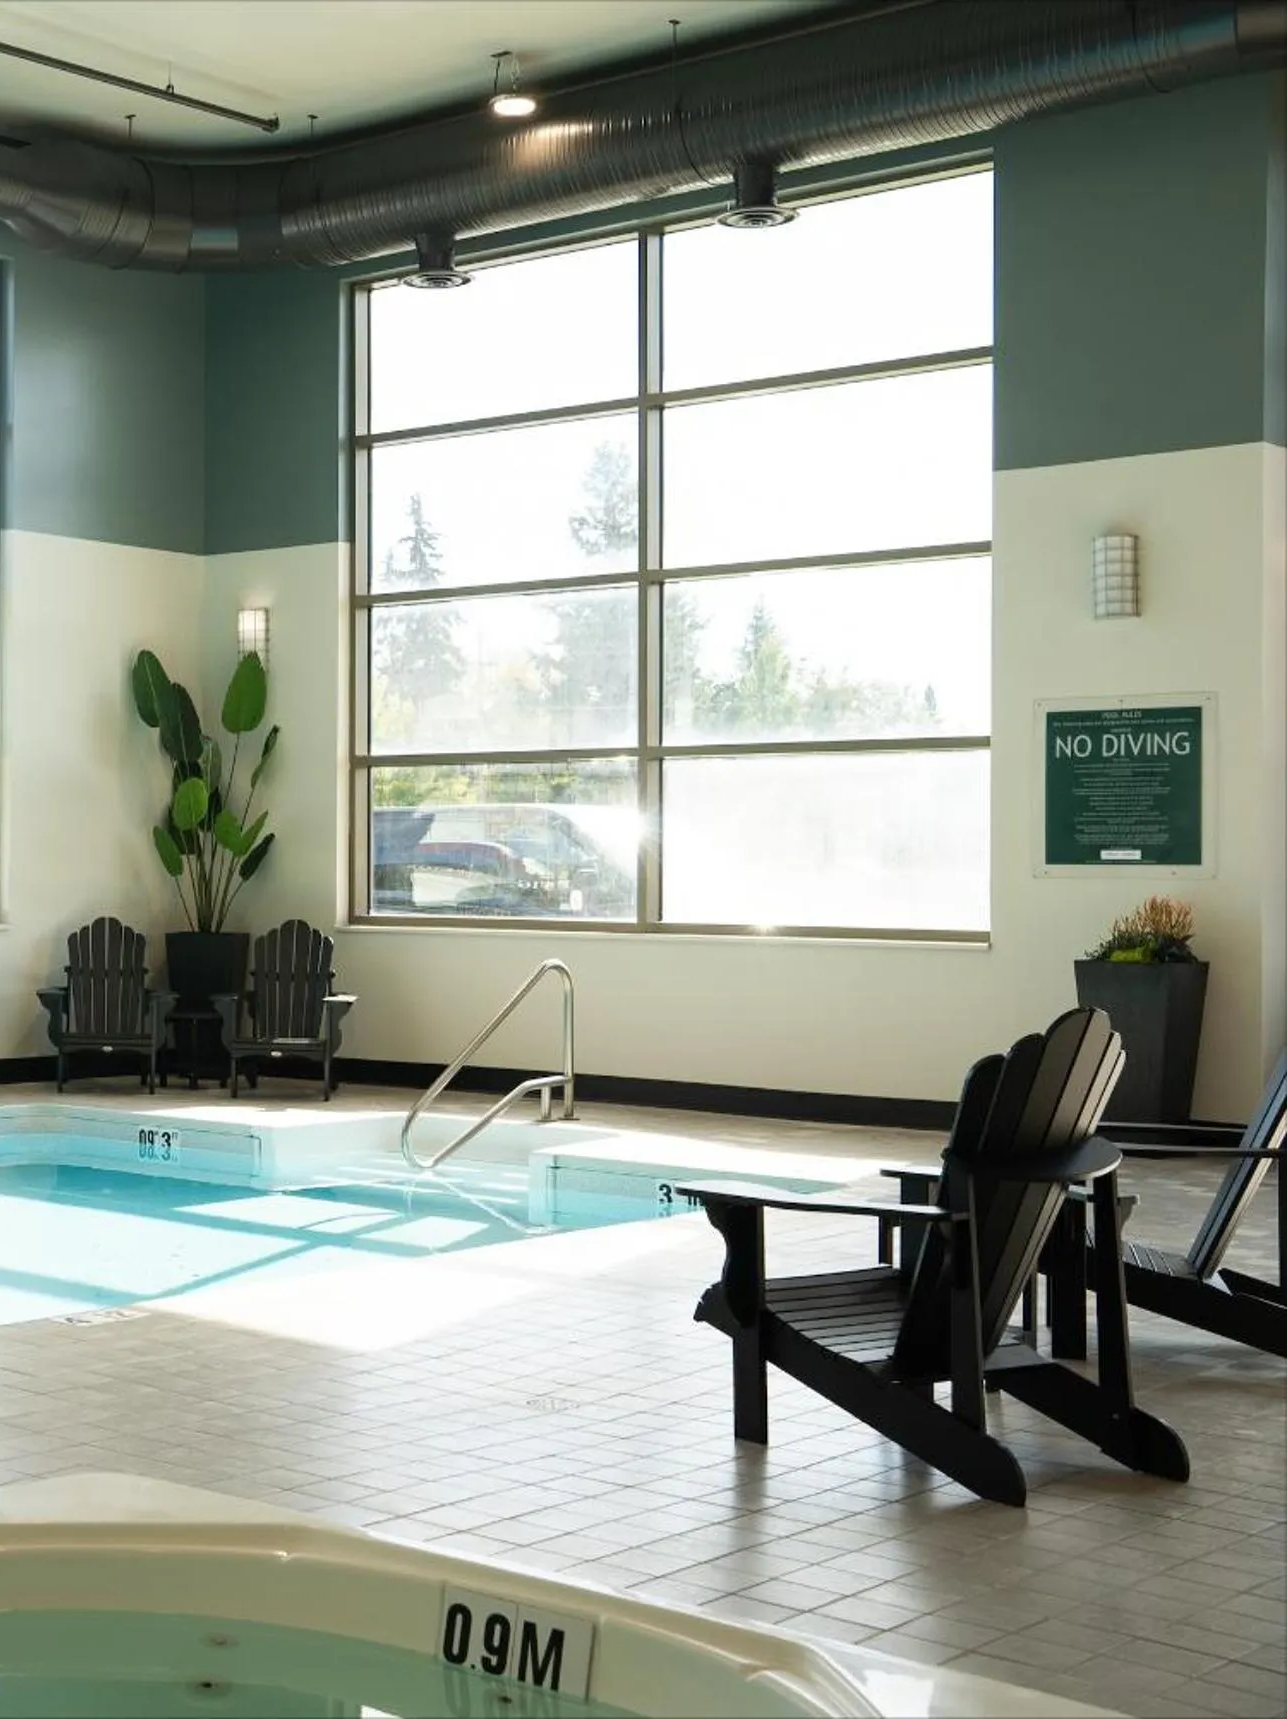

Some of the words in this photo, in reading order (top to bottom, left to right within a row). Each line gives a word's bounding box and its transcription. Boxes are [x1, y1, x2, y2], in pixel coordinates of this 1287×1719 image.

[1055, 735, 1092, 758] NO
[1102, 731, 1191, 757] DIVING
[443, 1602, 566, 1692] 0.9M
